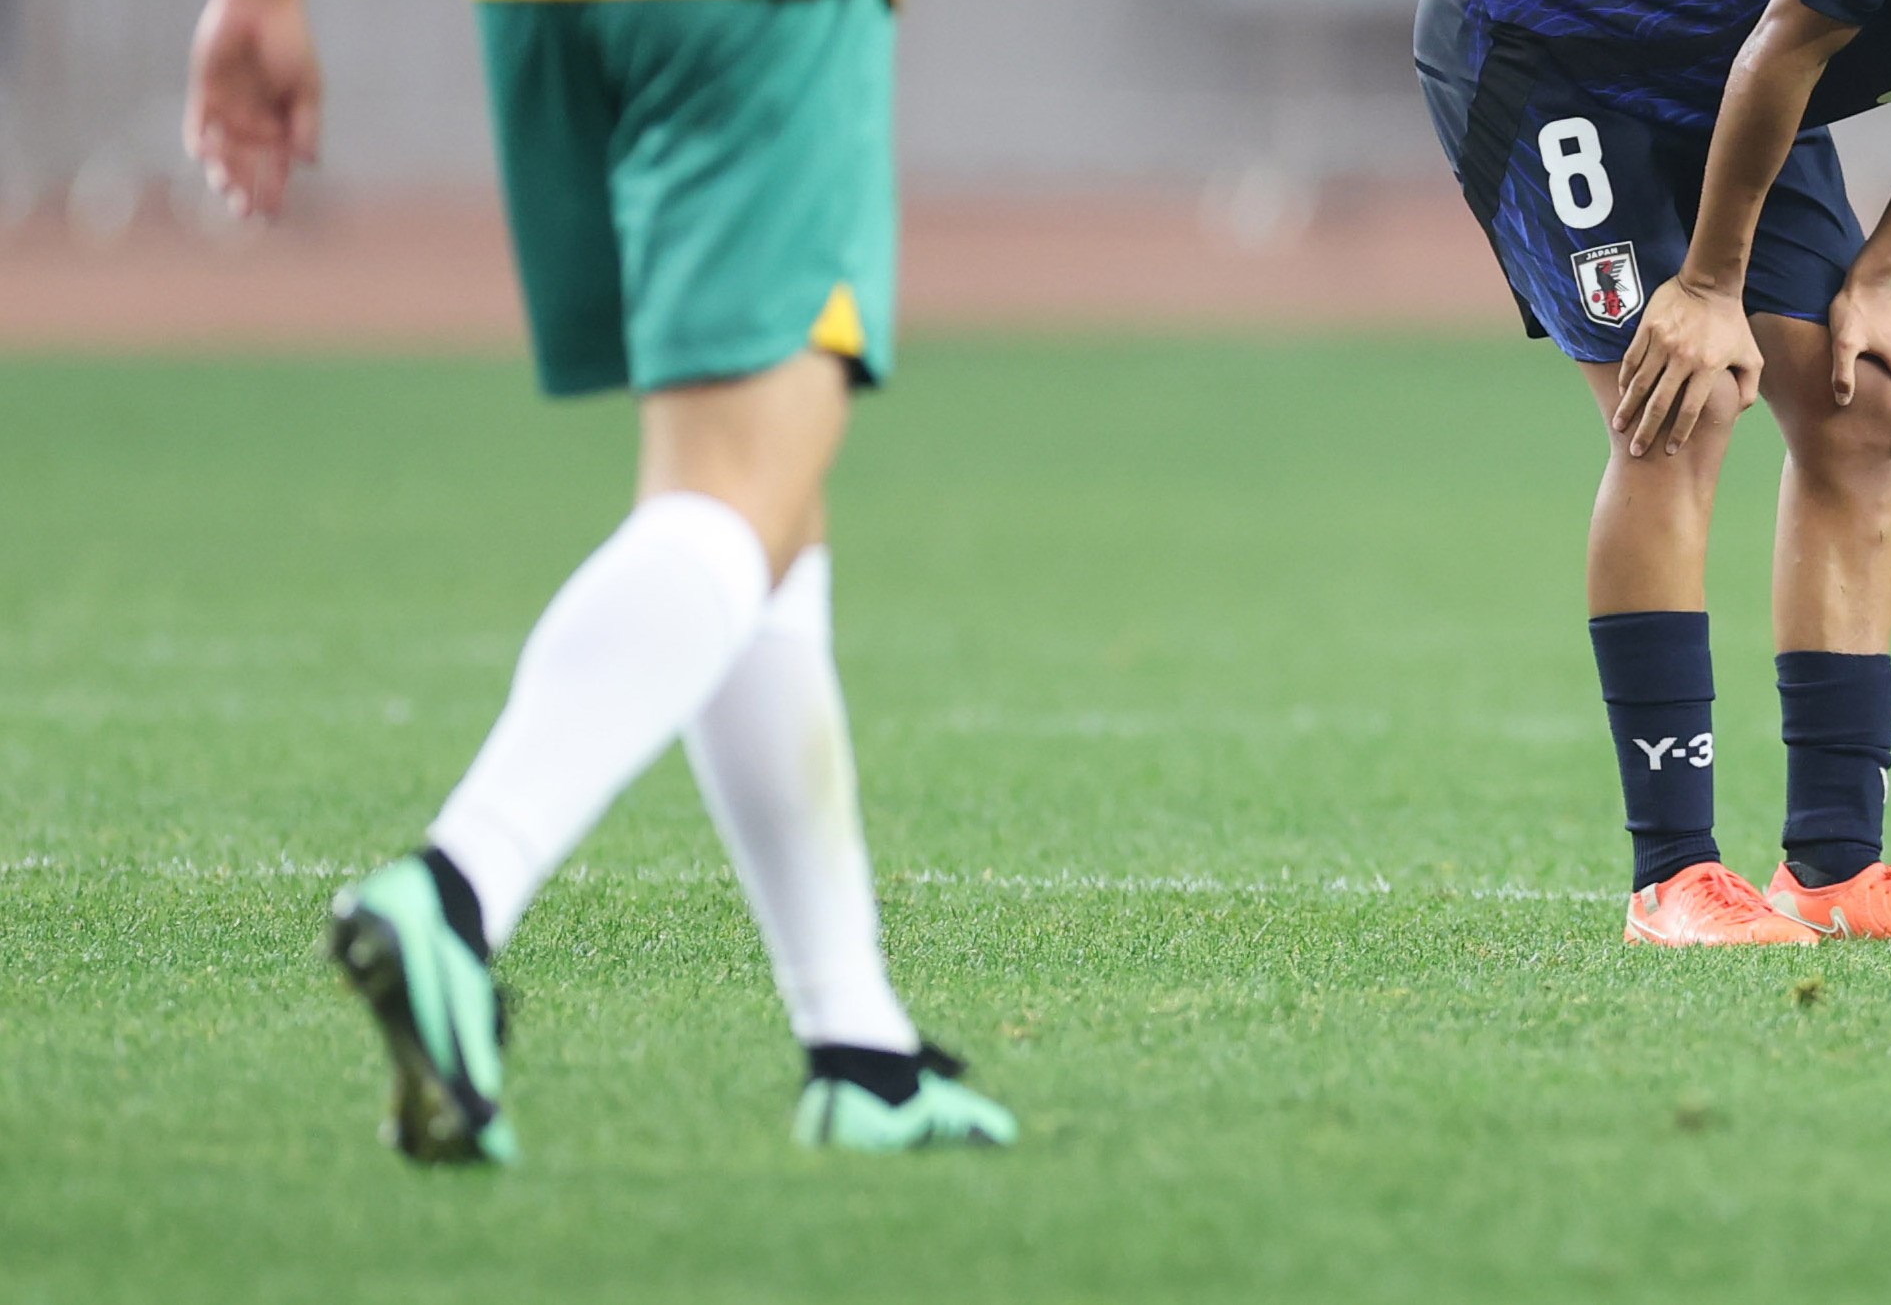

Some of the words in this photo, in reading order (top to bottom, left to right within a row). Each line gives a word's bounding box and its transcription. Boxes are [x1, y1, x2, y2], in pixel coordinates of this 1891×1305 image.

[1538, 117, 1614, 229] 8
[1585, 247, 1618, 261] JAPAN
[1633, 732, 1714, 770] Y-3
